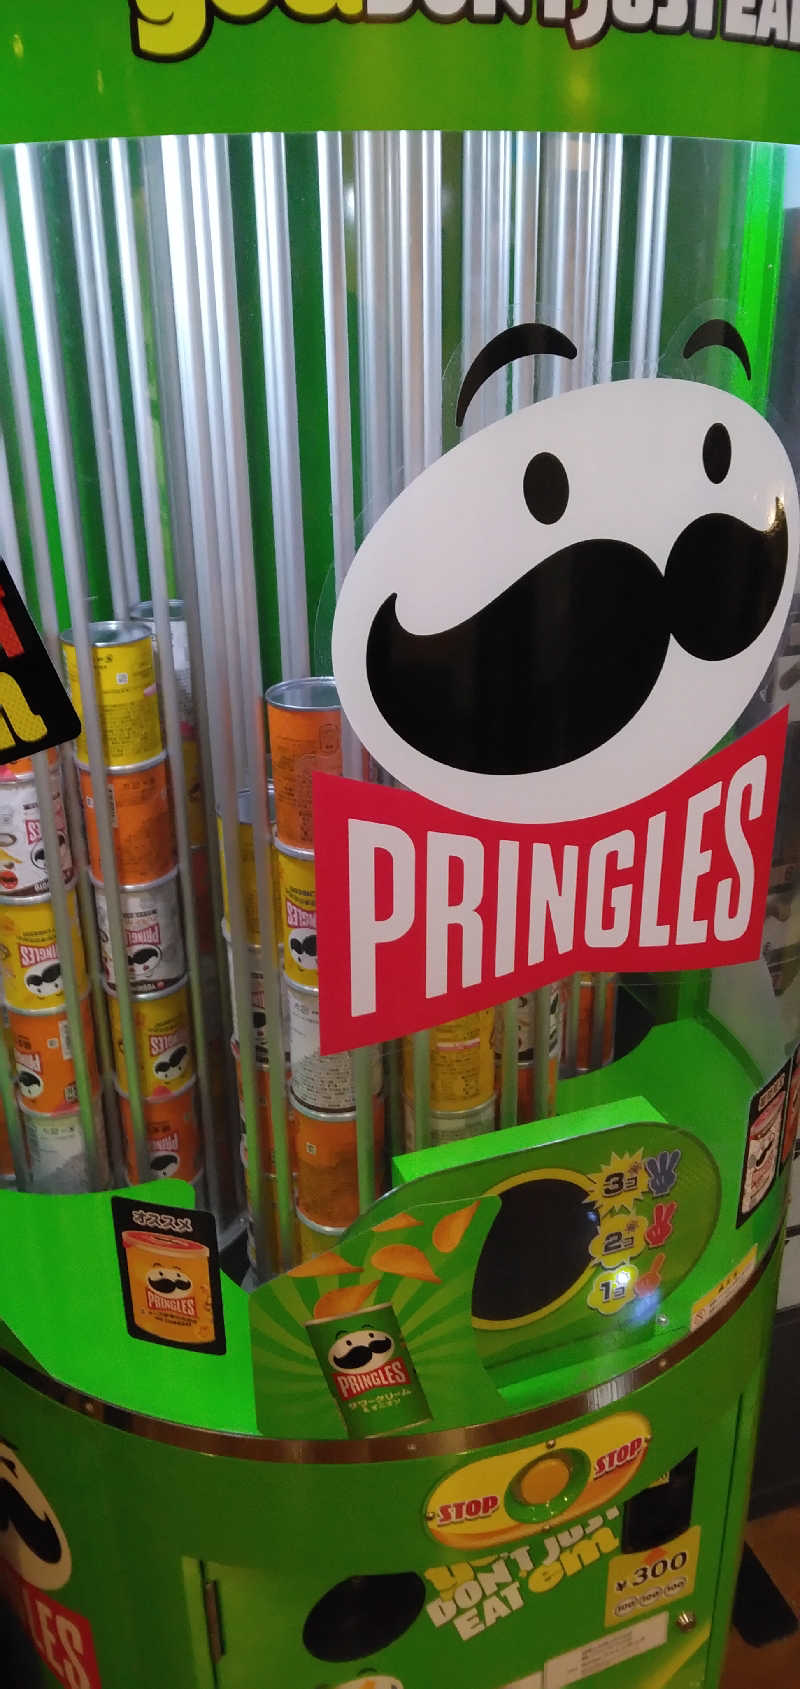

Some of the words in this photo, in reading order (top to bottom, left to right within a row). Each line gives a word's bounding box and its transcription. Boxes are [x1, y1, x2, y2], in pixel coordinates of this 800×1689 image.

[348, 754, 768, 1018] PRINGLES
[147, 1291, 195, 1315] PRINGLES
[337, 1361, 406, 1398] PRINGLES
[593, 1437, 644, 1480] STOP
[437, 1495, 499, 1526] STOP
[452, 1581, 524, 1641] EAT
